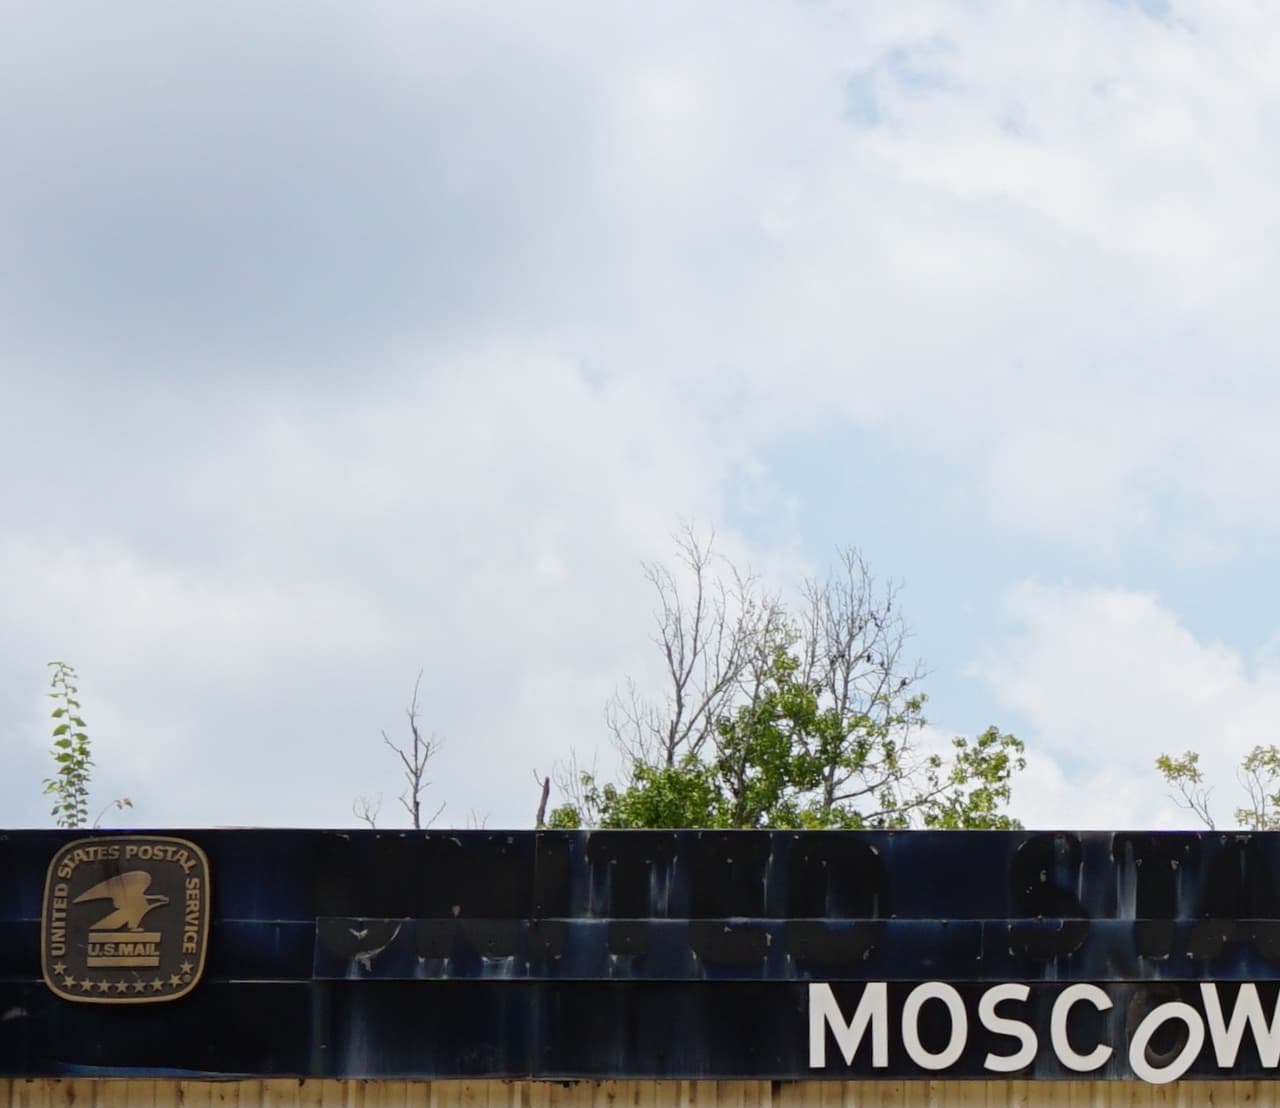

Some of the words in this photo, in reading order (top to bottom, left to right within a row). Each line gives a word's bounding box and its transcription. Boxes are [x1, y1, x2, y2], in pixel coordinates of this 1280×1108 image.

[58, 846, 121, 880] STATES
[125, 845, 198, 874] POSTAL
[51, 883, 68, 957] UNITED
[181, 877, 201, 954] SERVICE
